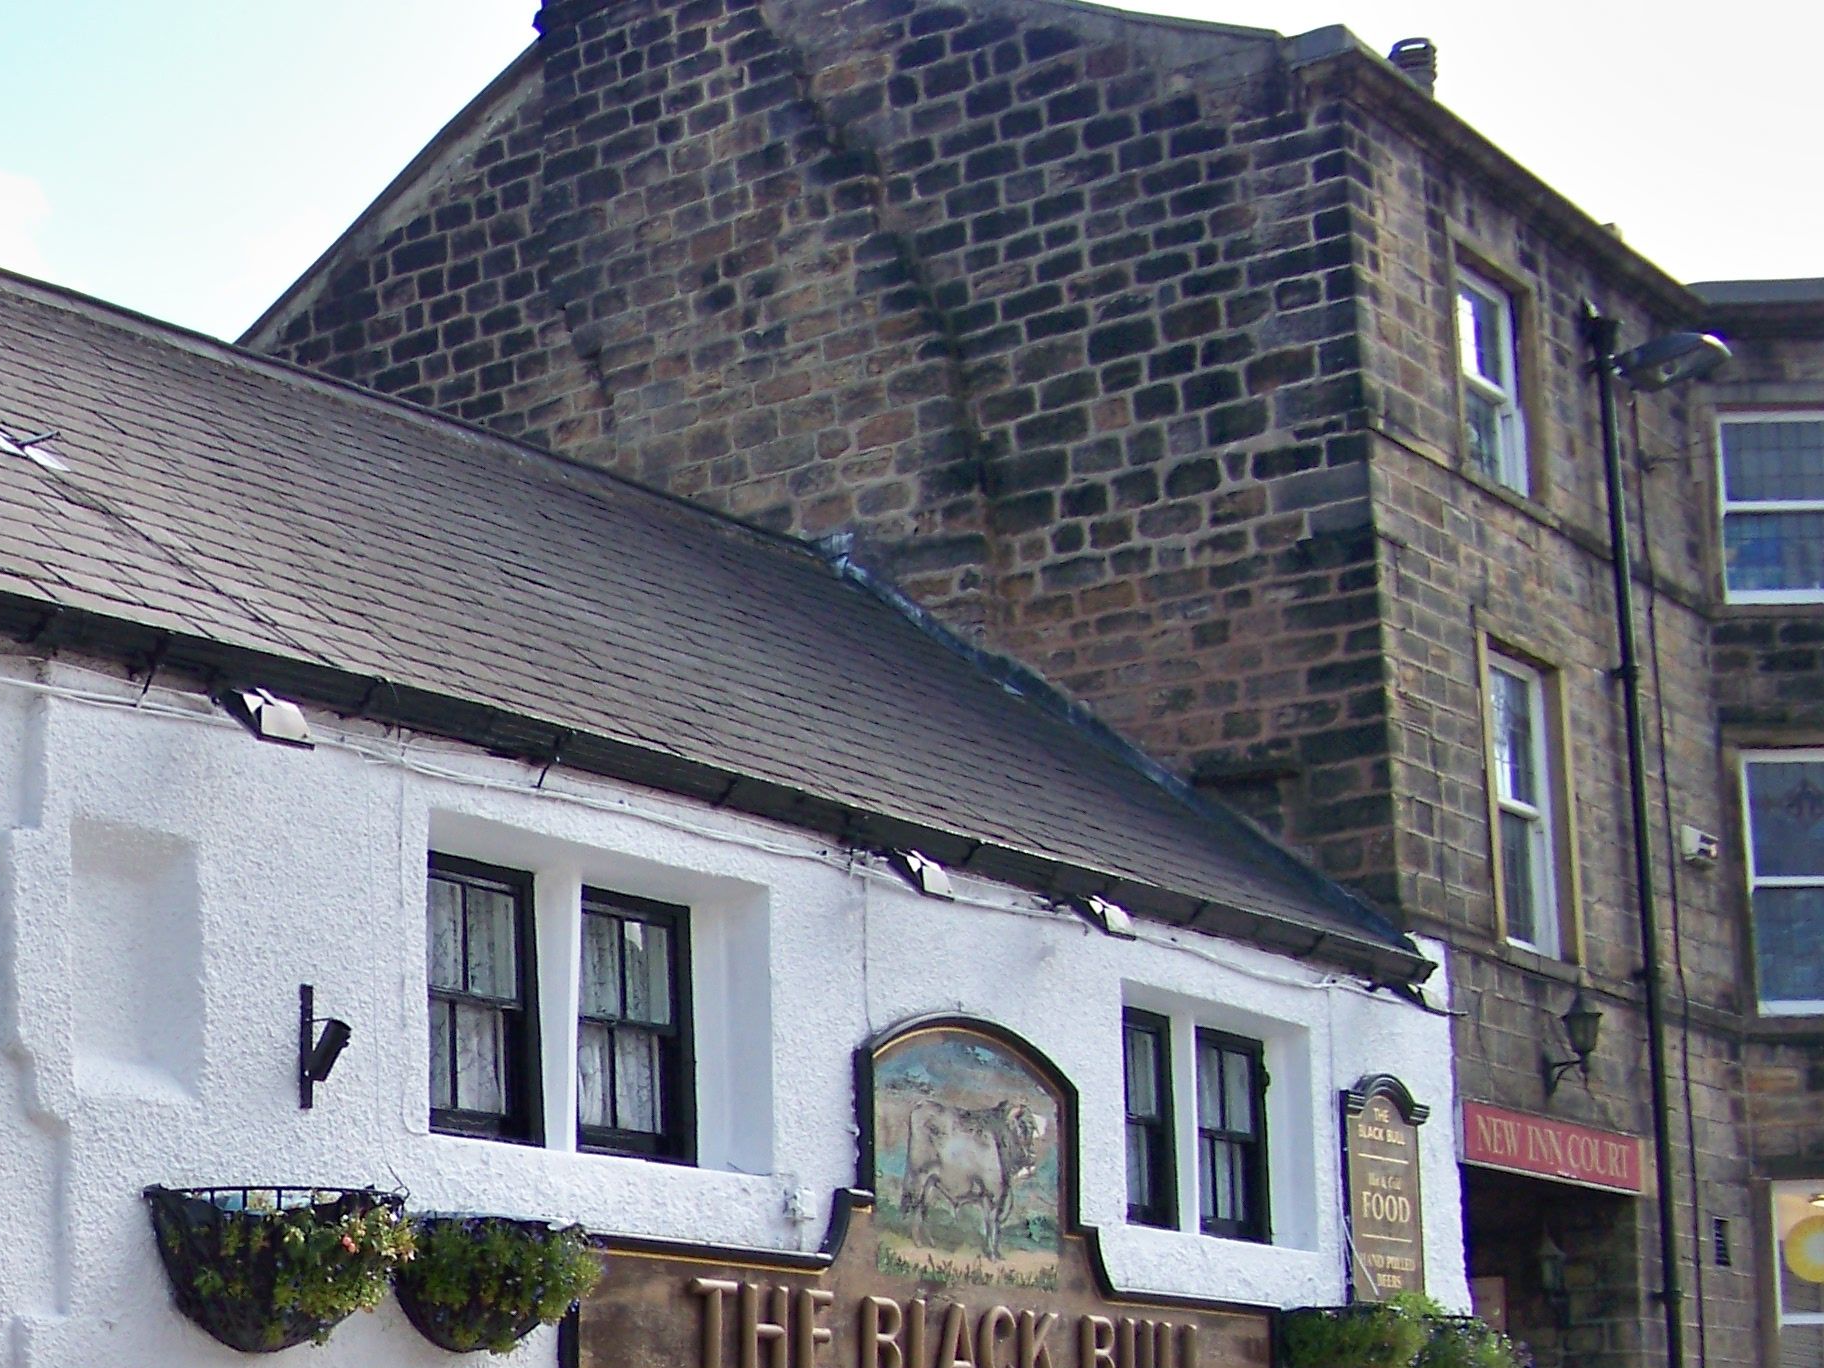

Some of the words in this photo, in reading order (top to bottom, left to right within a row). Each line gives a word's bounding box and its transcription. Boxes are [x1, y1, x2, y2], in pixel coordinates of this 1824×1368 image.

[1372, 1107, 1390, 1124] THE
[1358, 1123, 1385, 1142] BLACK
[1385, 1129, 1407, 1146] BULL
[1476, 1114, 1521, 1157] NEW
[1527, 1124, 1563, 1166] INN
[1567, 1133, 1632, 1179] COURT
[1361, 1191, 1411, 1223] FOOD
[1386, 1254, 1416, 1272] PULLED
[1376, 1272, 1403, 1288] BEERS
